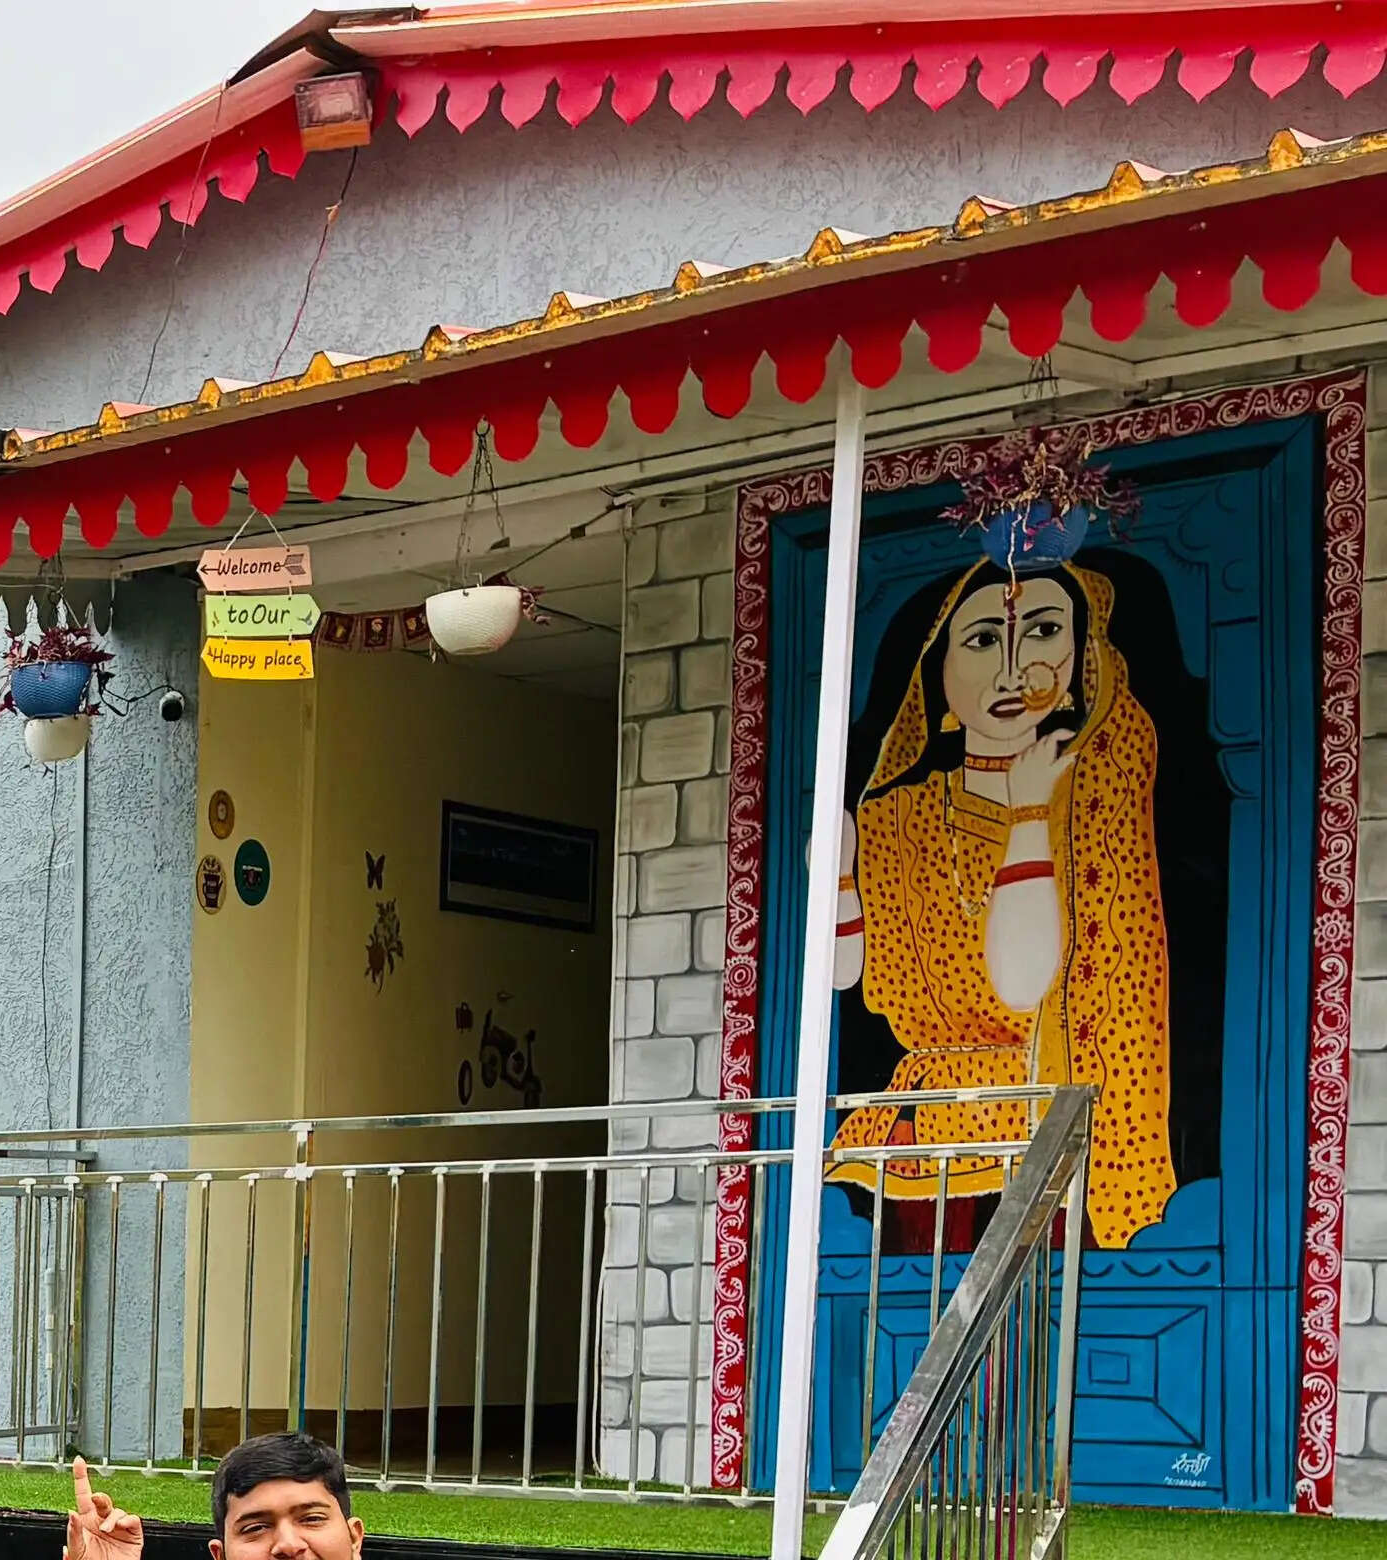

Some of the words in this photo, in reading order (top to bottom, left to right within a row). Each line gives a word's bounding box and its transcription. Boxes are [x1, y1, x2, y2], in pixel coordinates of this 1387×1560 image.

[217, 558, 281, 576] Welcome
[228, 604, 249, 625] to
[251, 604, 291, 625] Our
[213, 648, 256, 669] Happy
[264, 650, 302, 669] place
